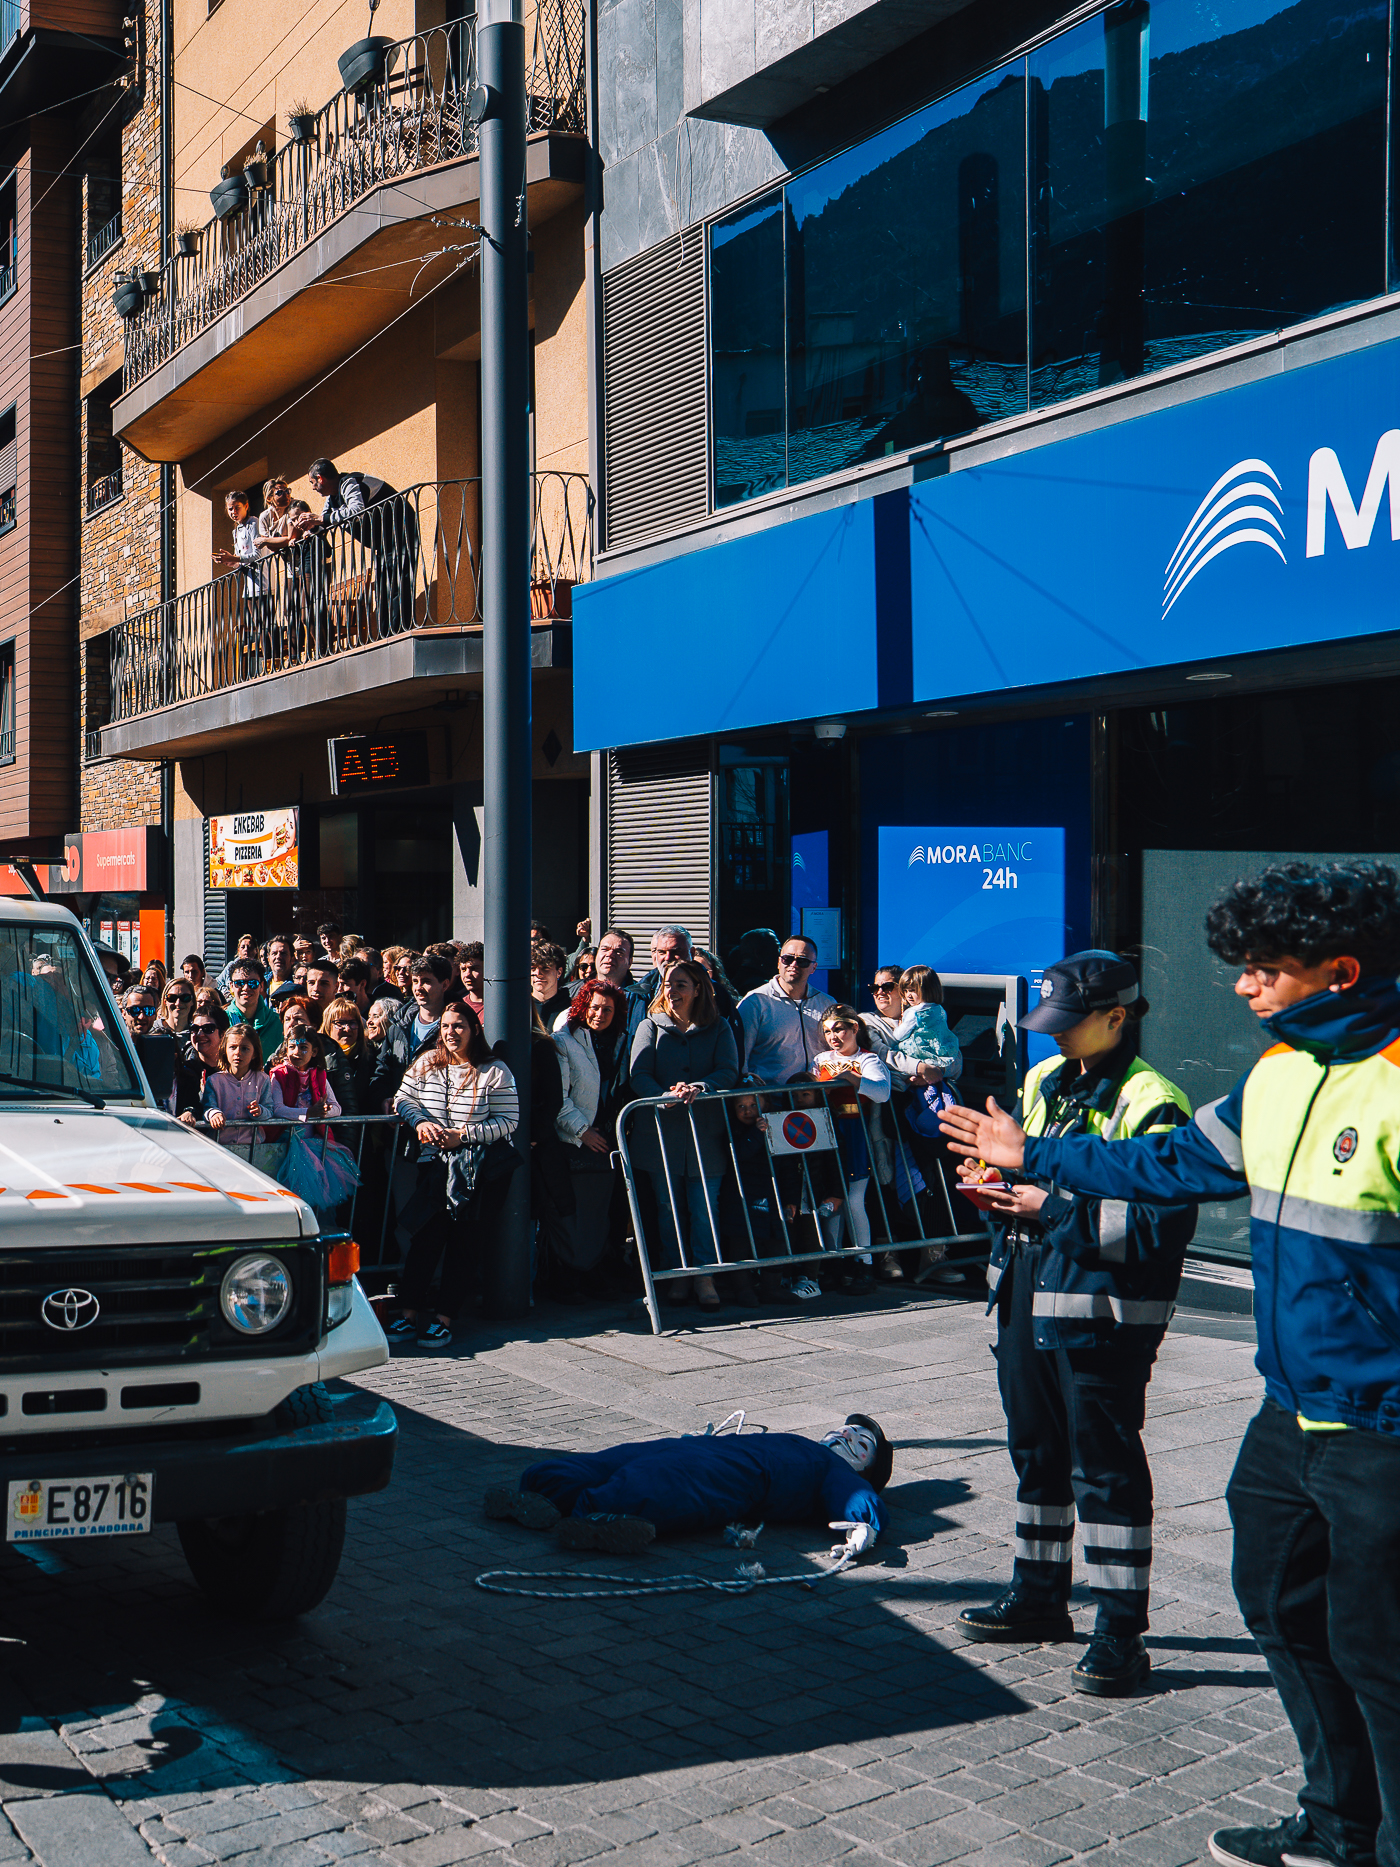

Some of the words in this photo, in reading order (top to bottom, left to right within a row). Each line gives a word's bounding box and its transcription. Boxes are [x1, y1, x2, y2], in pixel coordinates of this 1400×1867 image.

[233, 814, 265, 835] ENKEBAB
[96, 850, 136, 870] Supermercats
[234, 845, 263, 861] PIZZERIA
[927, 841, 1033, 864] MORABANC
[982, 866, 1018, 889] 24h
[47, 1481, 148, 1524] E8716
[13, 1526, 76, 1539] PRINCIPAT
[79, 1522, 144, 1535] D'ANDORRA
